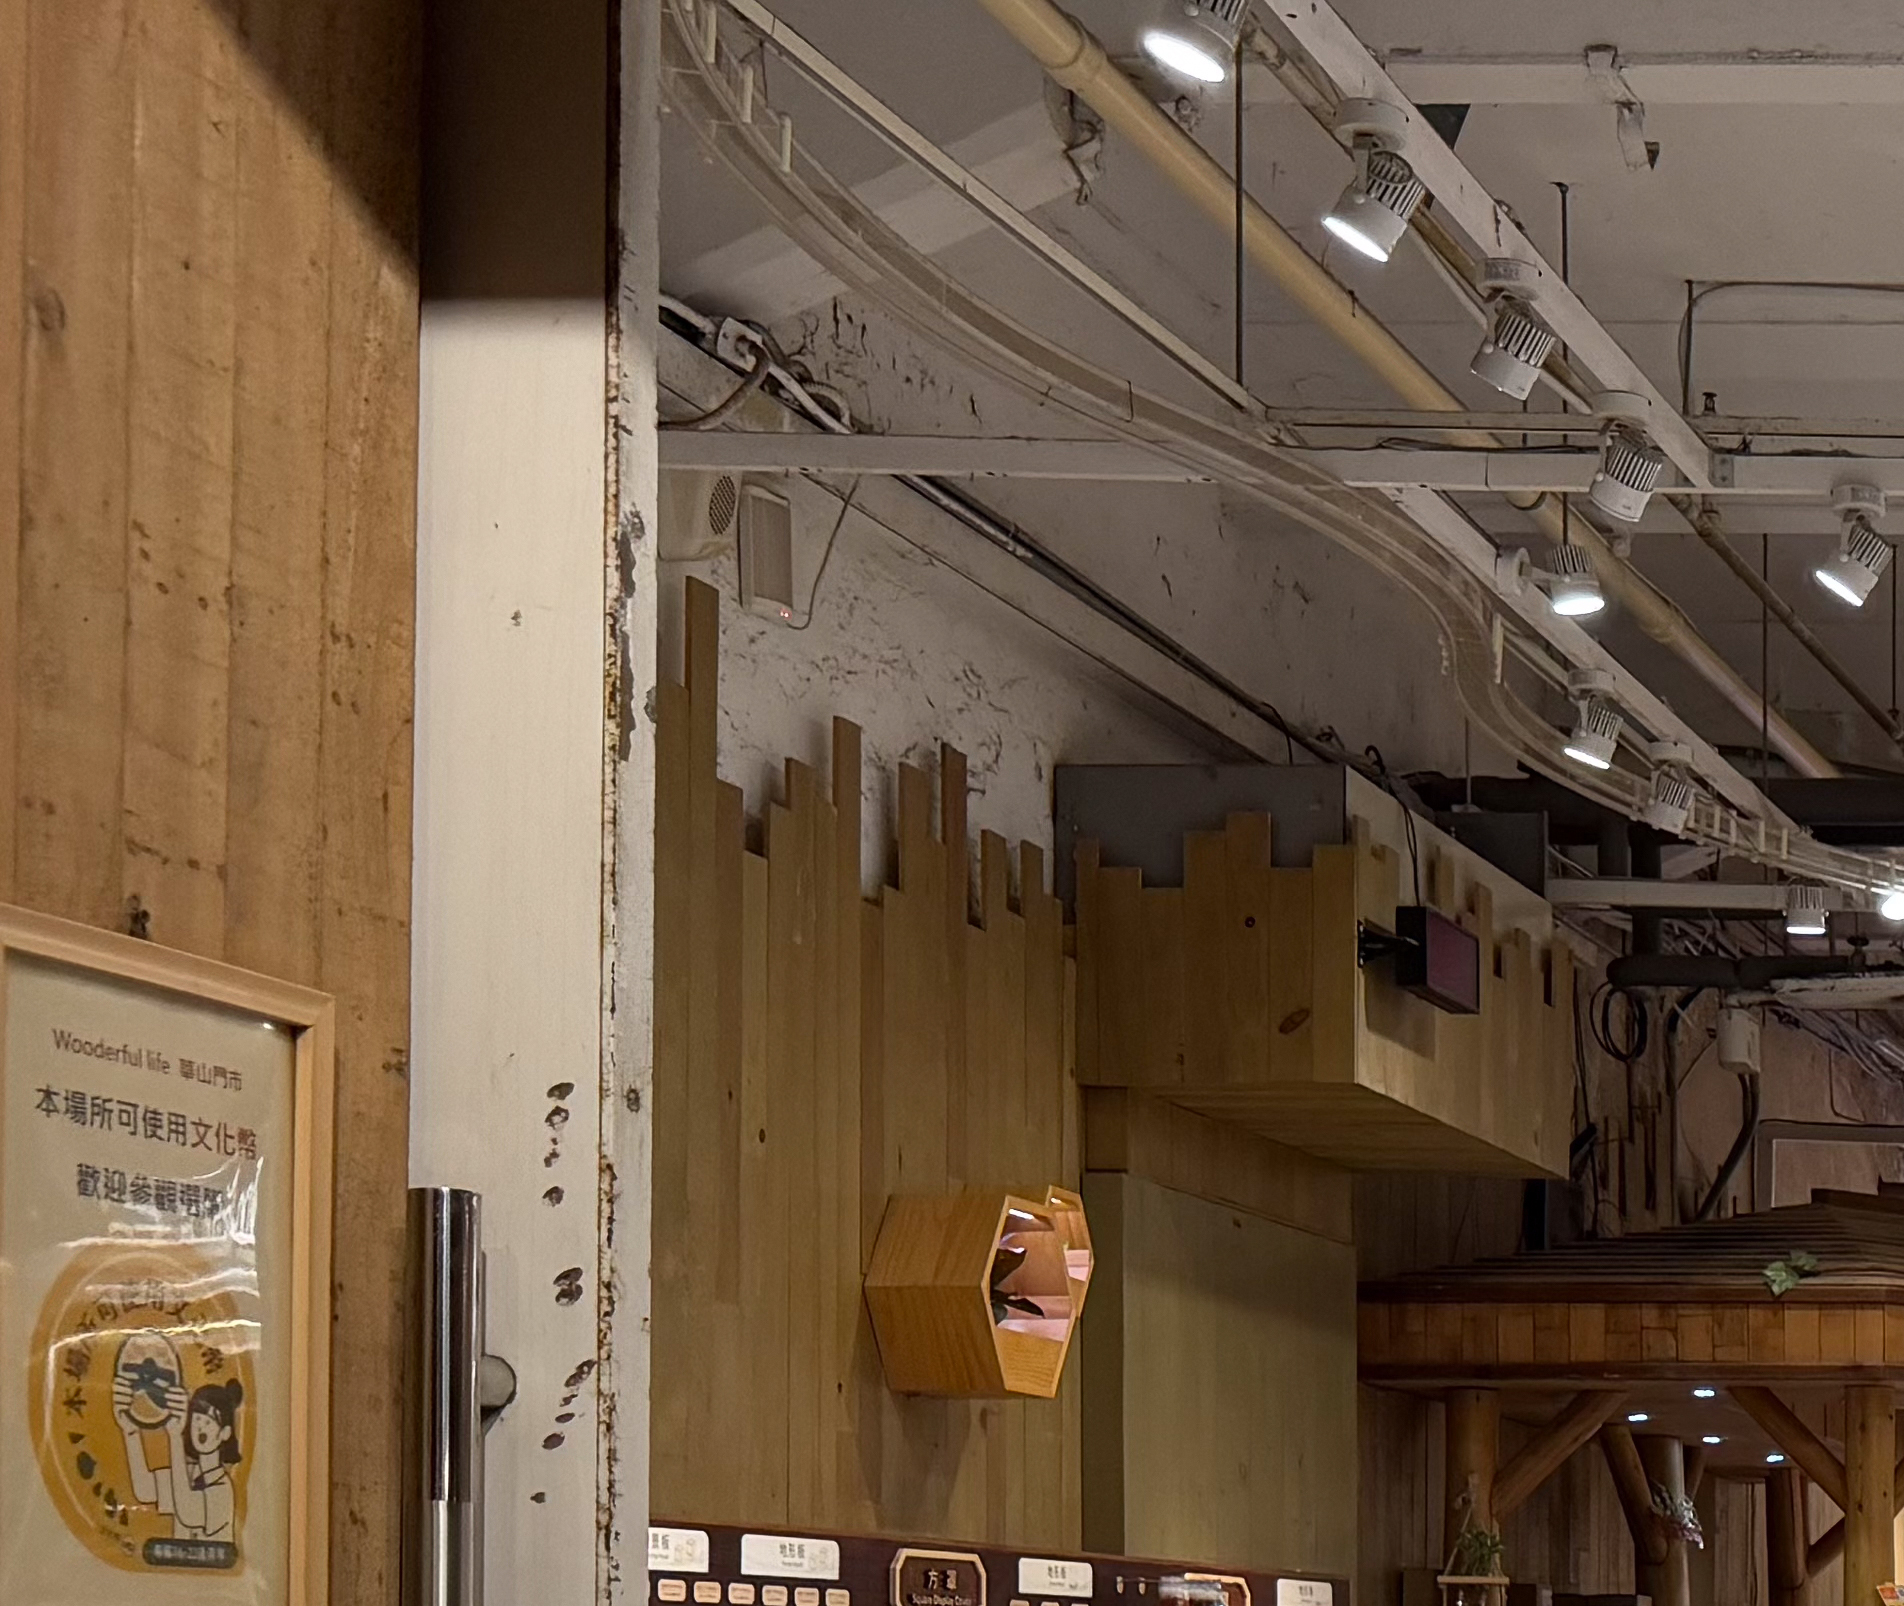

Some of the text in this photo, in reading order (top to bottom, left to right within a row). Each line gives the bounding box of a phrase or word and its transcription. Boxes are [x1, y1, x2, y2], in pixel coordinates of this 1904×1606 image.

[52, 1028, 243, 1091] Wooderful life 華山門市
[35, 1084, 257, 1160] 本場所可使用文化幣
